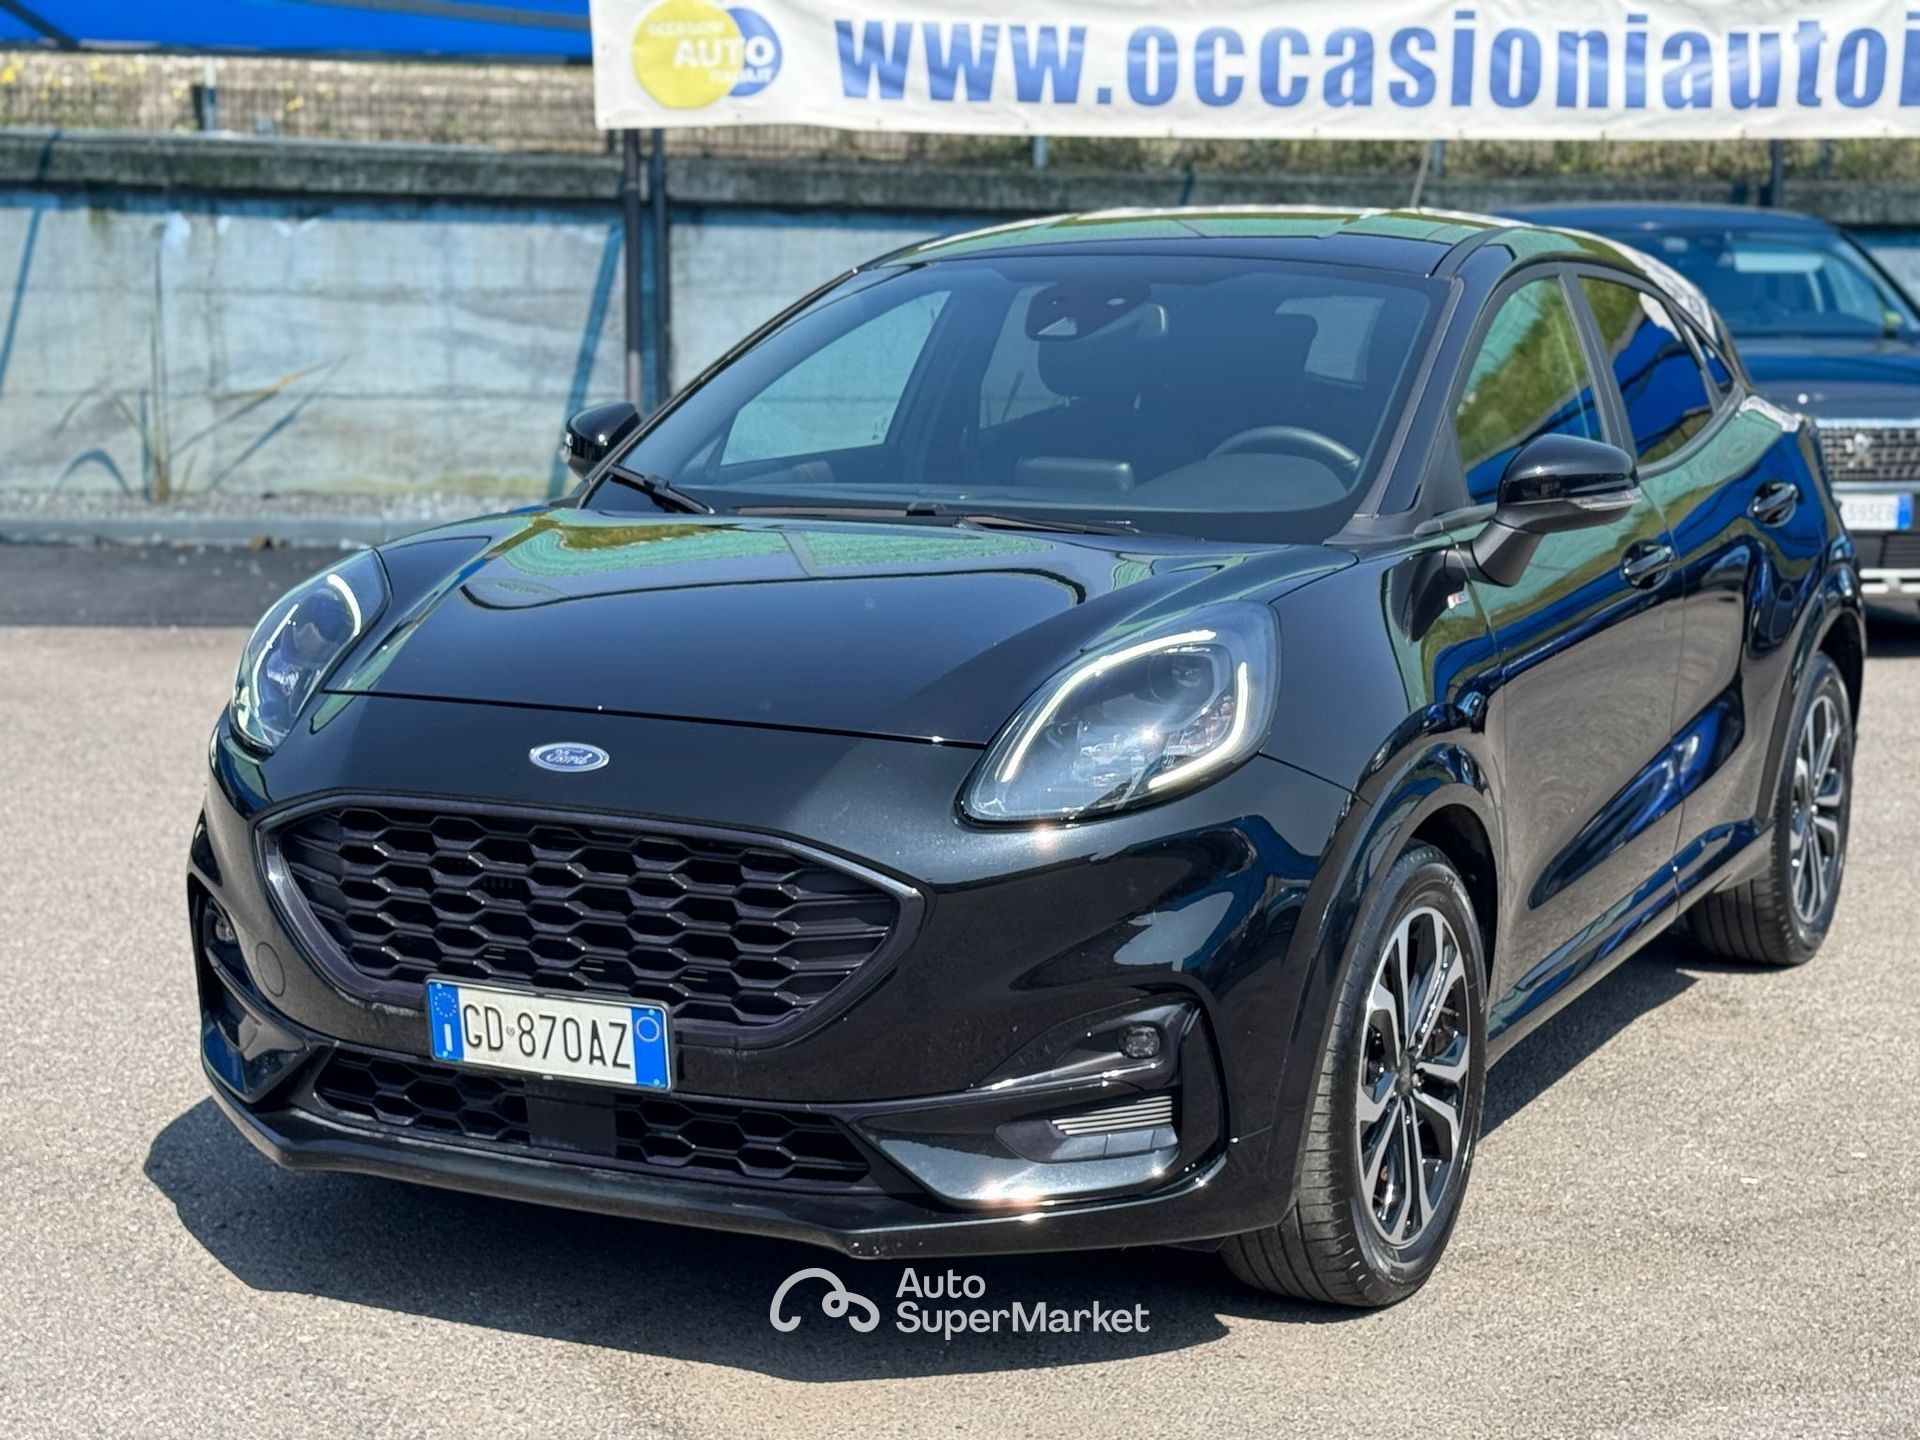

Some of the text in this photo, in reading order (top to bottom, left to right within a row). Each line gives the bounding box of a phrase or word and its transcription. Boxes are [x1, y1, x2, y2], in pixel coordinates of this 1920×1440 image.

[671, 35, 776, 68] AUTO
[545, 748, 593, 765] Ford
[517, 1012, 631, 1070] 870AZ
